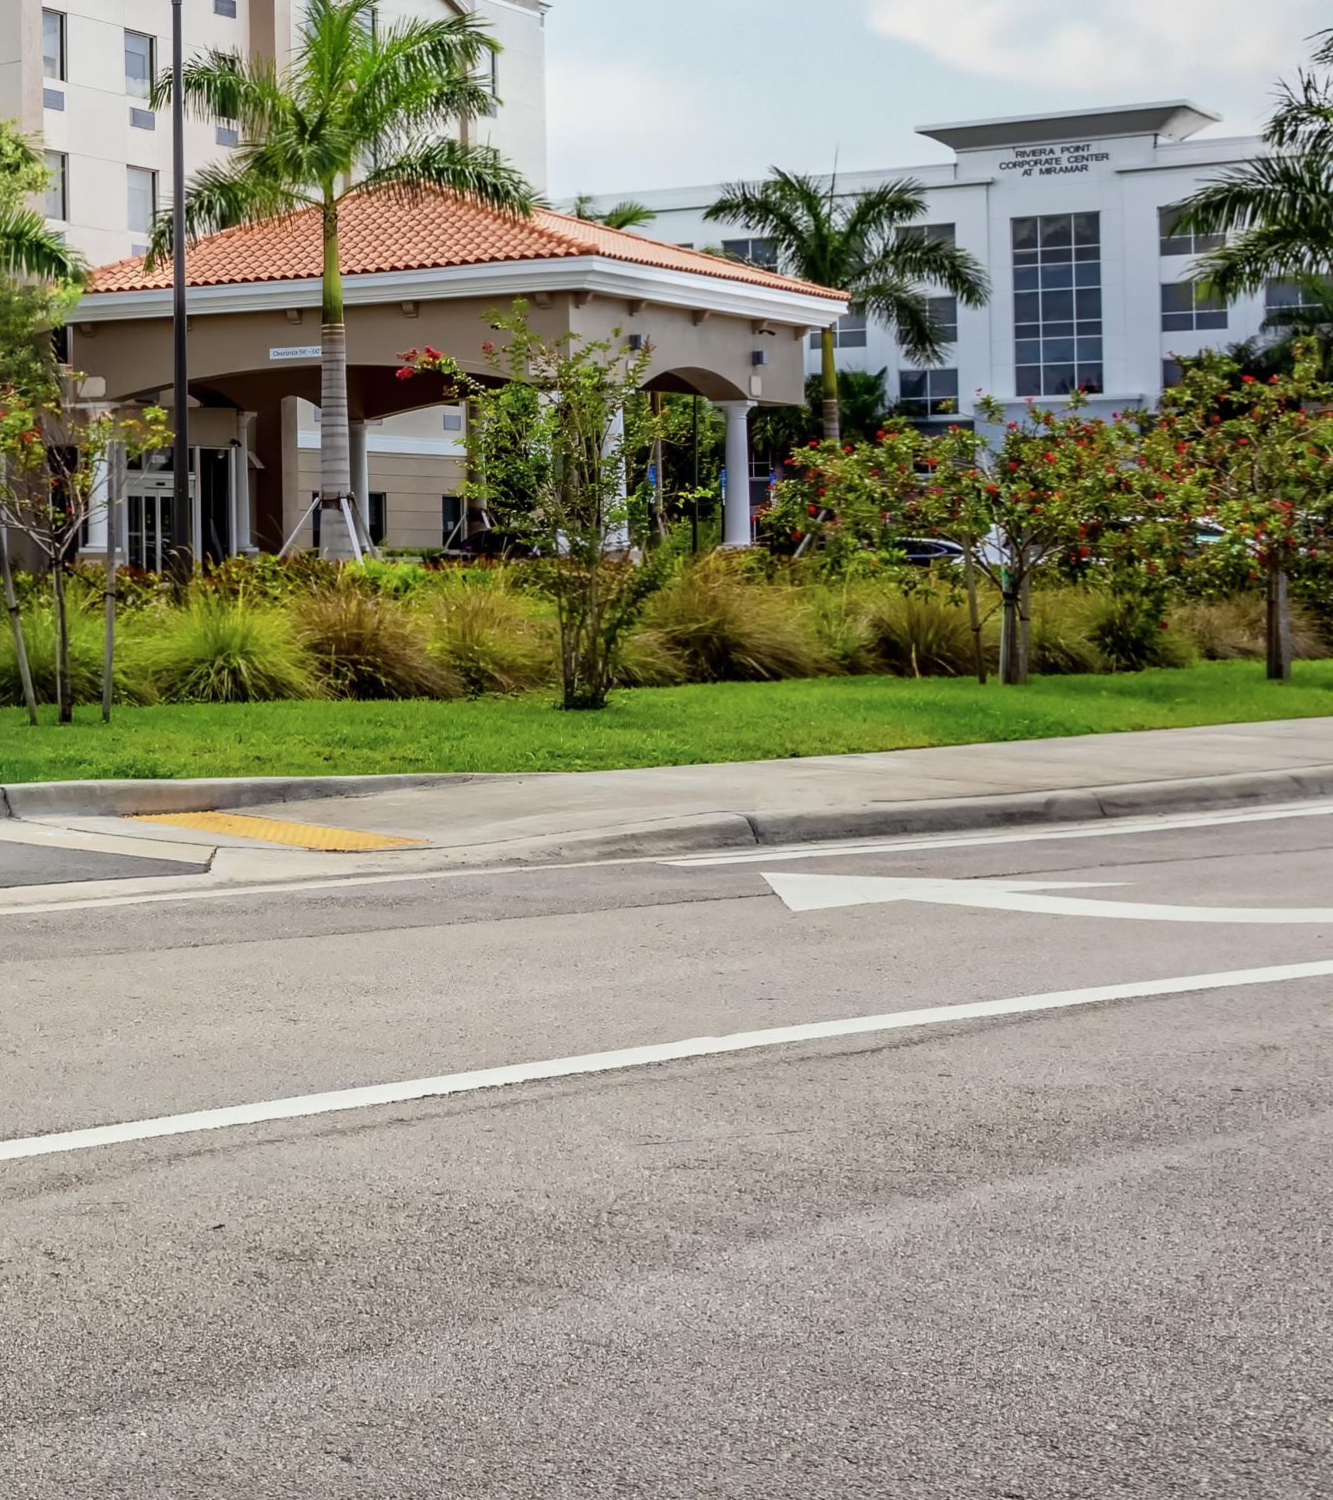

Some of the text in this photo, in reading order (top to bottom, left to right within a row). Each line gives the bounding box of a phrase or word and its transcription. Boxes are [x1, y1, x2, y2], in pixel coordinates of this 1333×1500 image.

[1015, 143, 1092, 158] RIVIERA POINT
[999, 153, 1110, 170] CORPORATE CENTER
[1021, 164, 1089, 177] AT MIRAMAR
